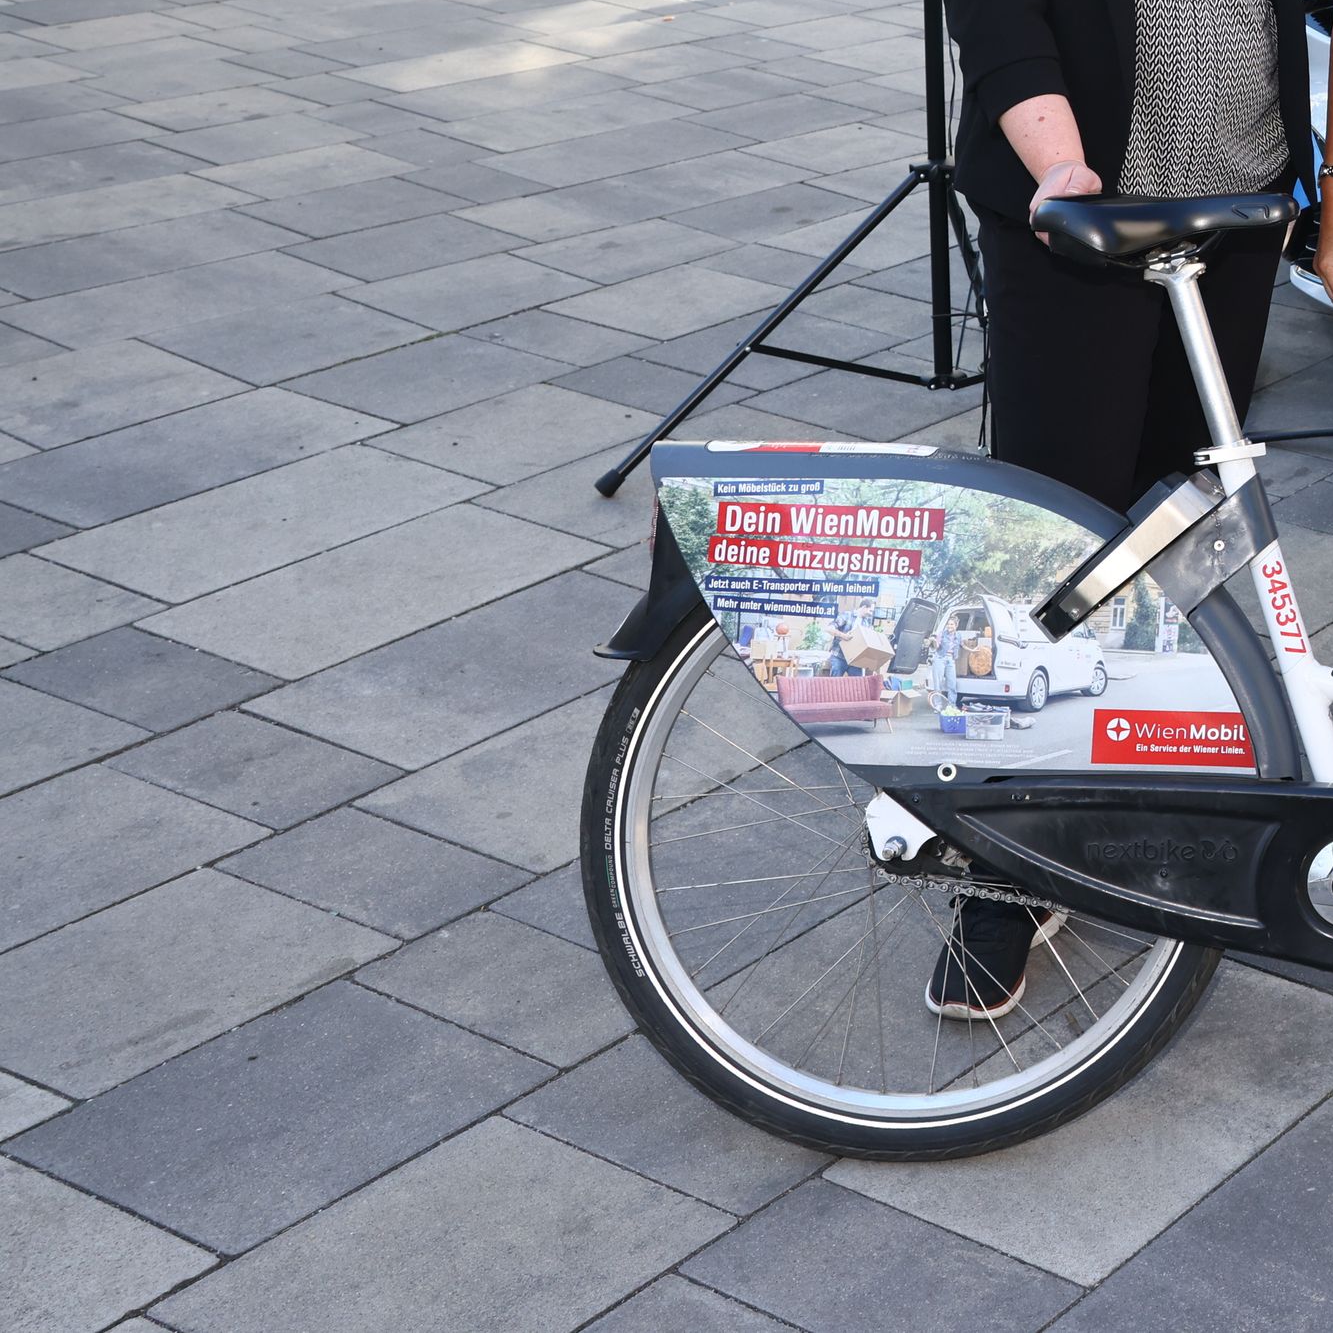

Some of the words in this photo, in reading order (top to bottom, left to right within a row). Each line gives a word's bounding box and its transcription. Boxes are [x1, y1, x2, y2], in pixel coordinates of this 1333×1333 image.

[717, 483, 736, 494] Kein
[738, 481, 786, 493] Möbelstück
[788, 483, 799, 493] zu
[801, 482, 820, 494] groß
[725, 505, 781, 534] Dein
[791, 507, 938, 542] WienMobil,
[714, 539, 770, 564] deine
[777, 544, 914, 575] Umzugshilfe.
[709, 578, 729, 590] Jetzt
[730, 580, 751, 590] auch
[753, 580, 810, 594] E-Transporter
[812, 582, 821, 592] in
[822, 583, 844, 593] Wien
[846, 583, 875, 594] leihen!
[717, 598, 739, 609] Mehr
[740, 600, 762, 610] unter
[764, 601, 835, 616] wienmobilauto.at
[1262, 560, 1307, 654] 345377
[1135, 723, 1246, 741] WienMobil
[1136, 743, 1148, 752] Ein
[1150, 744, 1178, 753] Service
[1179, 744, 1191, 753] der
[1193, 745, 1219, 754] Wiener
[1221, 746, 1246, 755] Linien.
[606, 768, 619, 814] CRUISER
[615, 736, 629, 764] PLUS
[1087, 838, 1195, 861] nextbike
[615, 912, 645, 978] SCHWALBE
